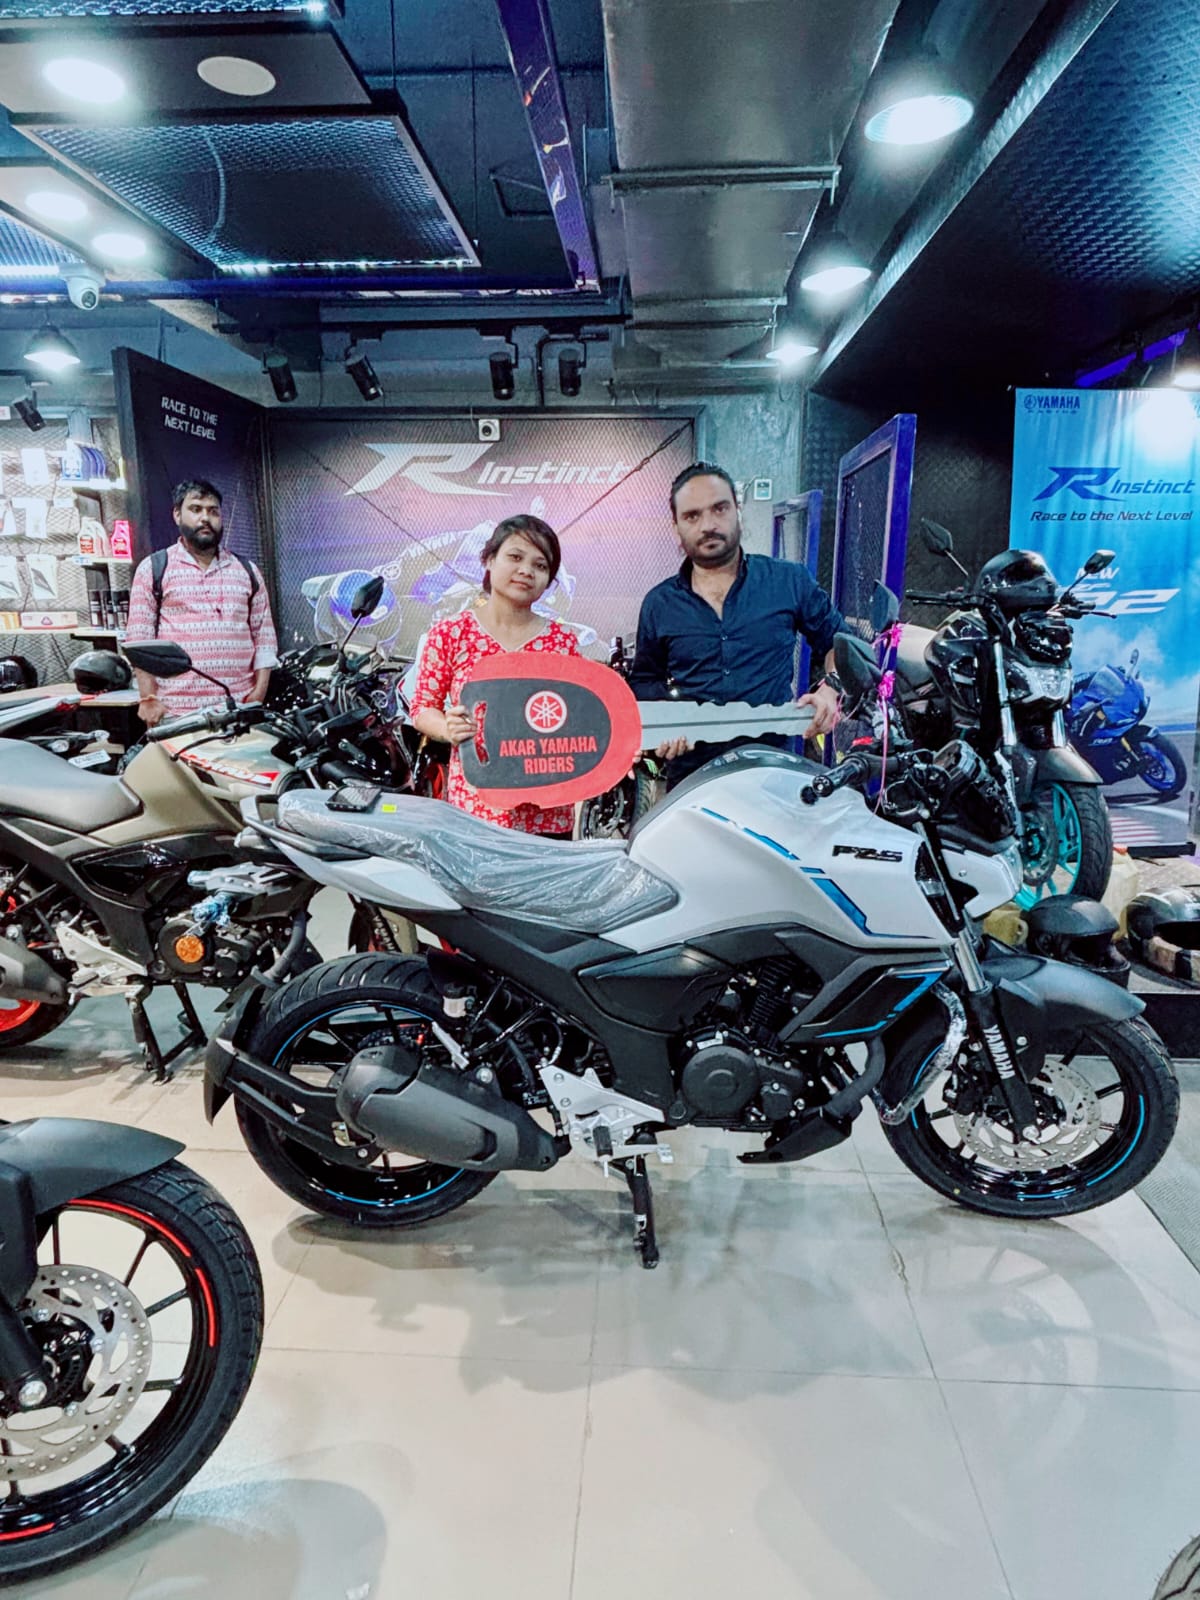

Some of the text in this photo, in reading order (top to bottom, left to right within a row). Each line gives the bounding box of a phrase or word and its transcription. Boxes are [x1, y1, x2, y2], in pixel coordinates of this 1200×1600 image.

[161, 396, 218, 426] RACE TO THE
[1037, 395, 1081, 409] YAMAHA
[164, 414, 216, 440] NEXT LEVEL
[477, 461, 633, 485] Instinct
[1110, 479, 1196, 494] Instinct
[1030, 510, 1193, 521] Race to the Next Level
[499, 736, 598, 757] AKAR YAMAHA
[524, 756, 575, 774] RIDERS
[983, 1024, 1016, 1080] YAMAHA
